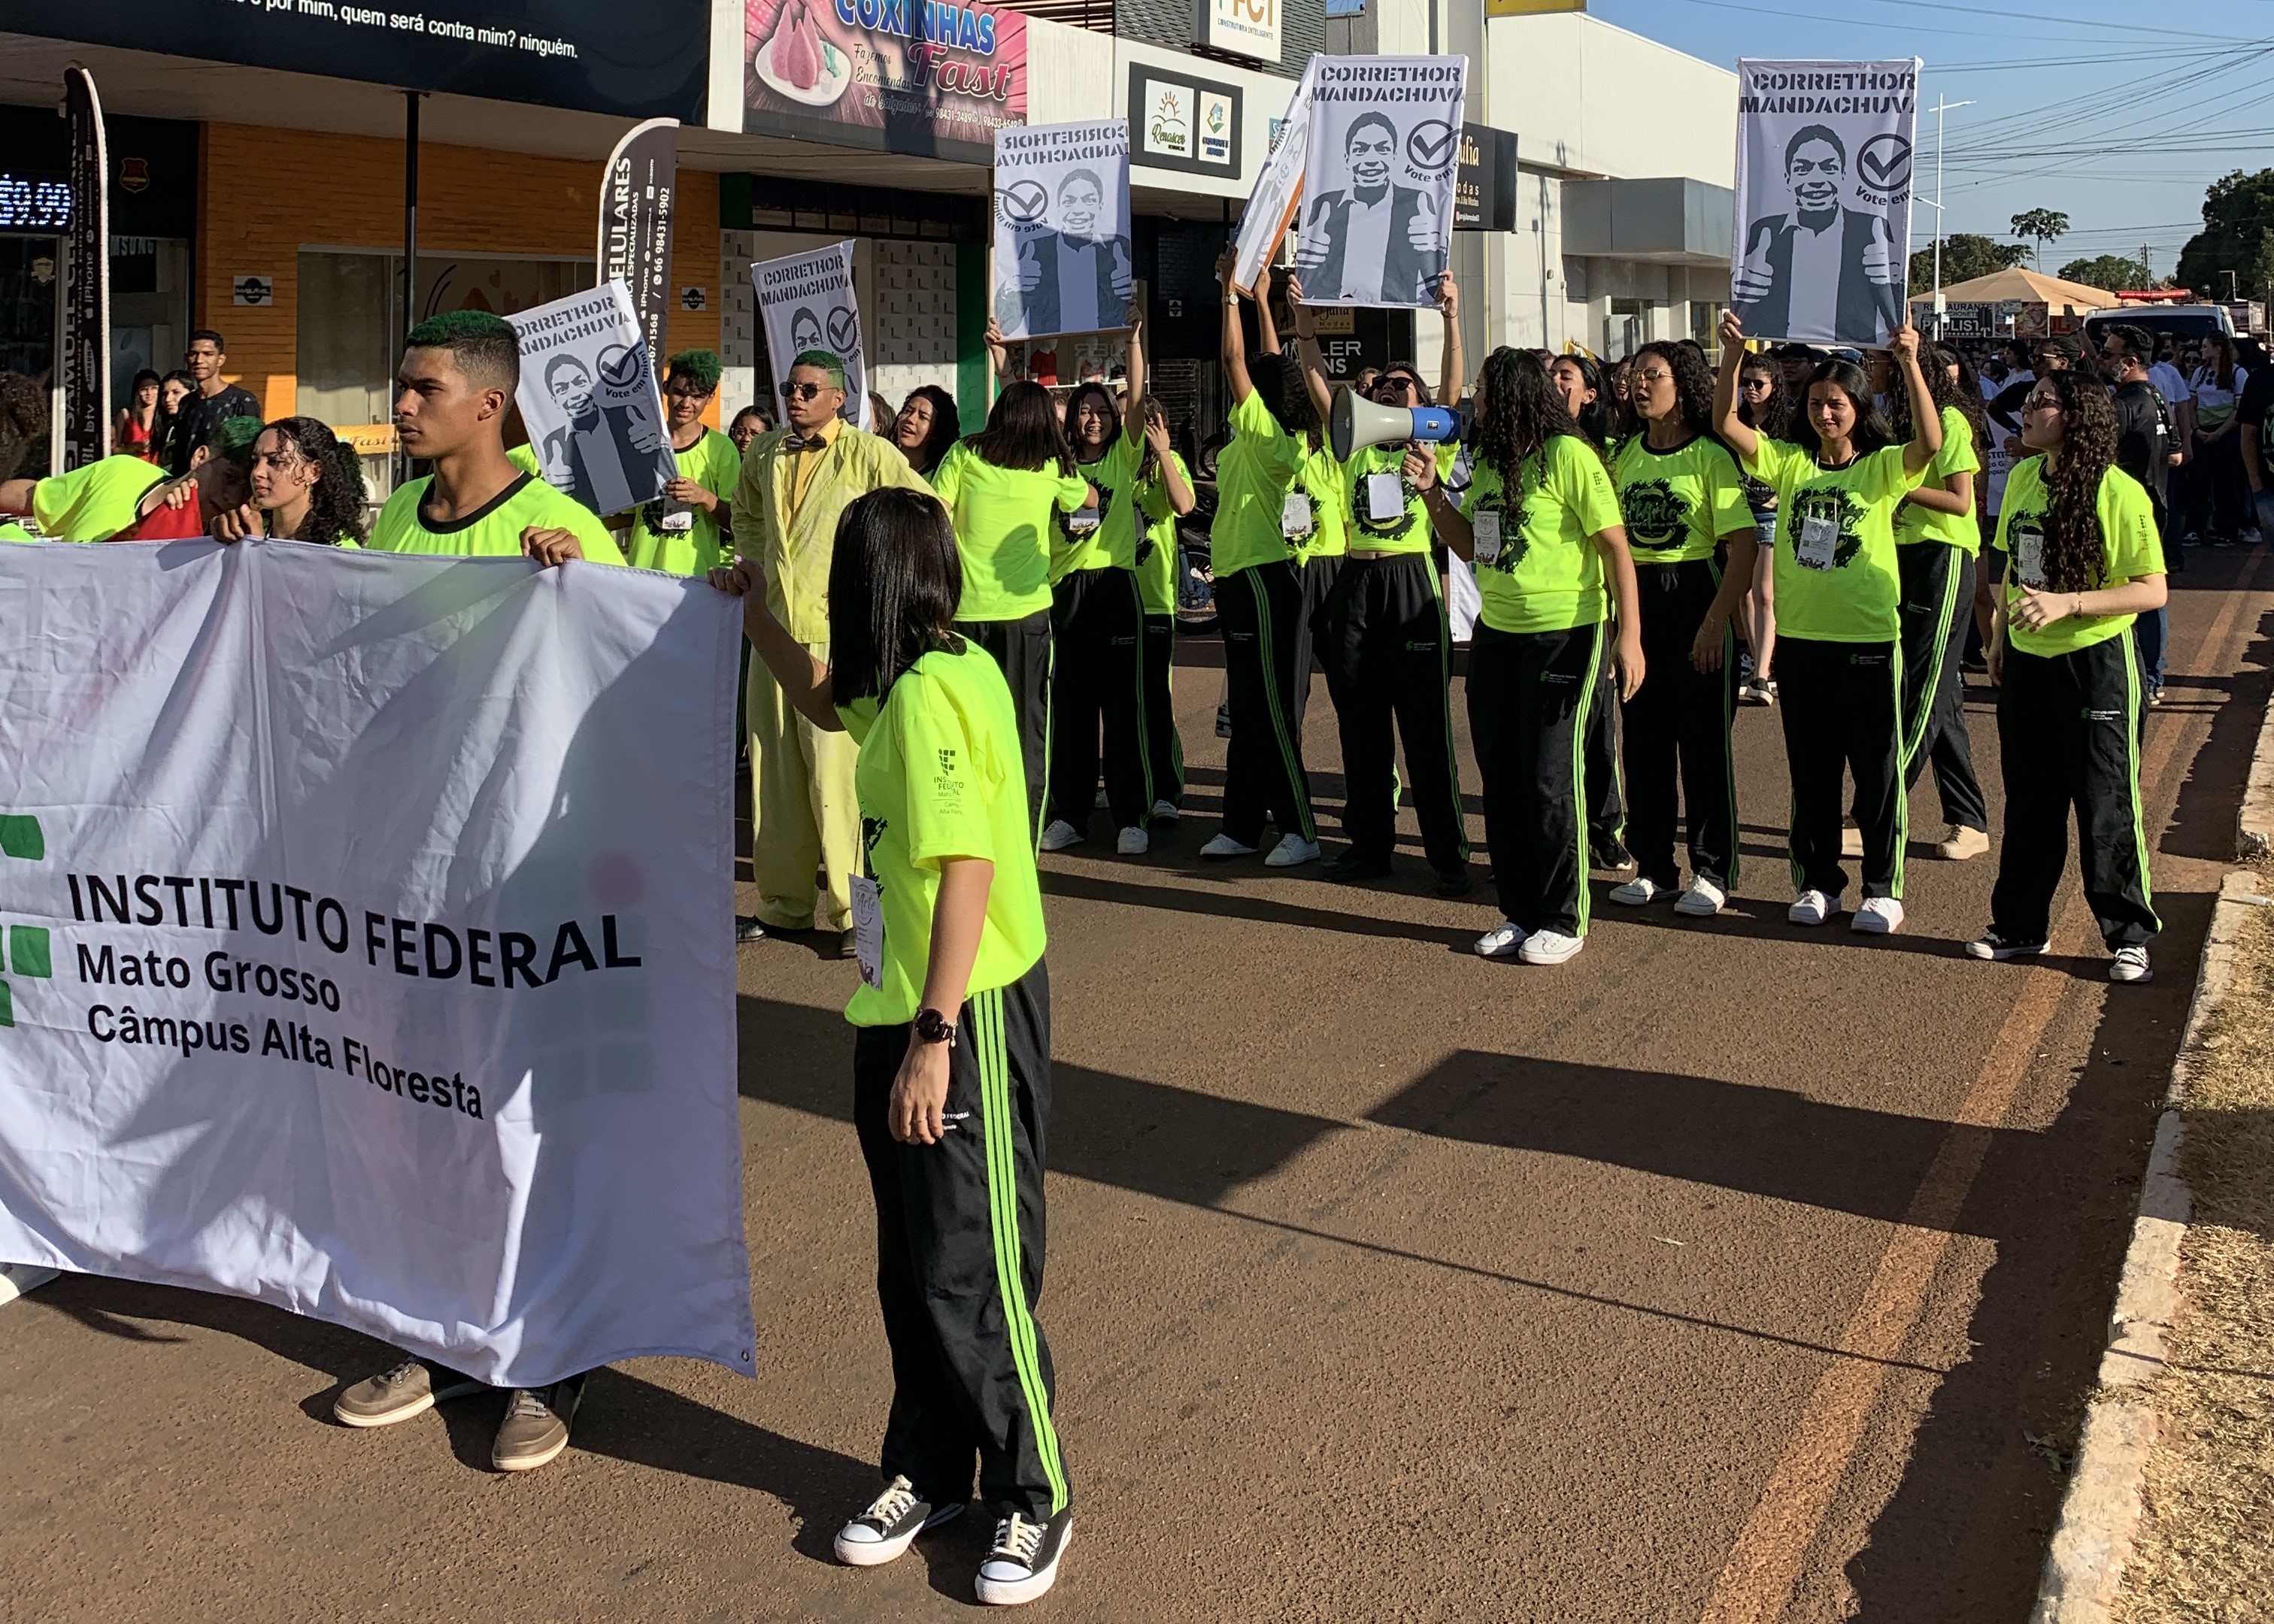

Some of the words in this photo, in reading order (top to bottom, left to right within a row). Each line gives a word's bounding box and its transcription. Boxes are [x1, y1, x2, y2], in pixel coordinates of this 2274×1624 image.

[299, 0, 338, 21] mim,
[341, 6, 386, 26] quem
[390, 14, 423, 32] será
[428, 20, 475, 41] contra
[478, 27, 517, 48] mim?
[520, 35, 578, 59] ninguém.
[835, 0, 996, 56] COXINHAS
[1217, 18, 1248, 33] CONSTRUTORA
[1248, 26, 1274, 40] INTELIGENTE
[854, 43, 892, 65] Fazemos
[856, 66, 911, 90] Encomendas
[908, 42, 1011, 102] Fast
[1321, 67, 1461, 82] CORRETHOR
[1753, 73, 1915, 90] CORRETHOR
[864, 94, 876, 106] de
[878, 95, 921, 114] Salgados:
[1739, 96, 1915, 114] MANDACHUV
[1459, 135, 1479, 167] ulia
[1404, 165, 1431, 182] Vote
[1457, 180, 1480, 195] odas
[1855, 185, 1887, 205] Vote
[609, 157, 631, 282] ELULARES
[626, 191, 639, 277] ESPECIALIZADAS
[655, 187, 670, 254] 98431-5902
[84, 252, 94, 303] iPhone
[655, 258, 663, 273] 66
[764, 254, 844, 286] CORRETHOR
[641, 267, 650, 308] iPhone
[517, 295, 617, 338] ORRETHOR
[605, 387, 630, 400] Vote
[67, 874, 350, 954] INSTITUTO
[365, 910, 642, 989] FEDERAL
[77, 944, 190, 990] Mato
[205, 950, 341, 1013] Grosso
[88, 1004, 250, 1058] Câmpus
[262, 1019, 333, 1071] Alta
[344, 1035, 485, 1120] Floresta
